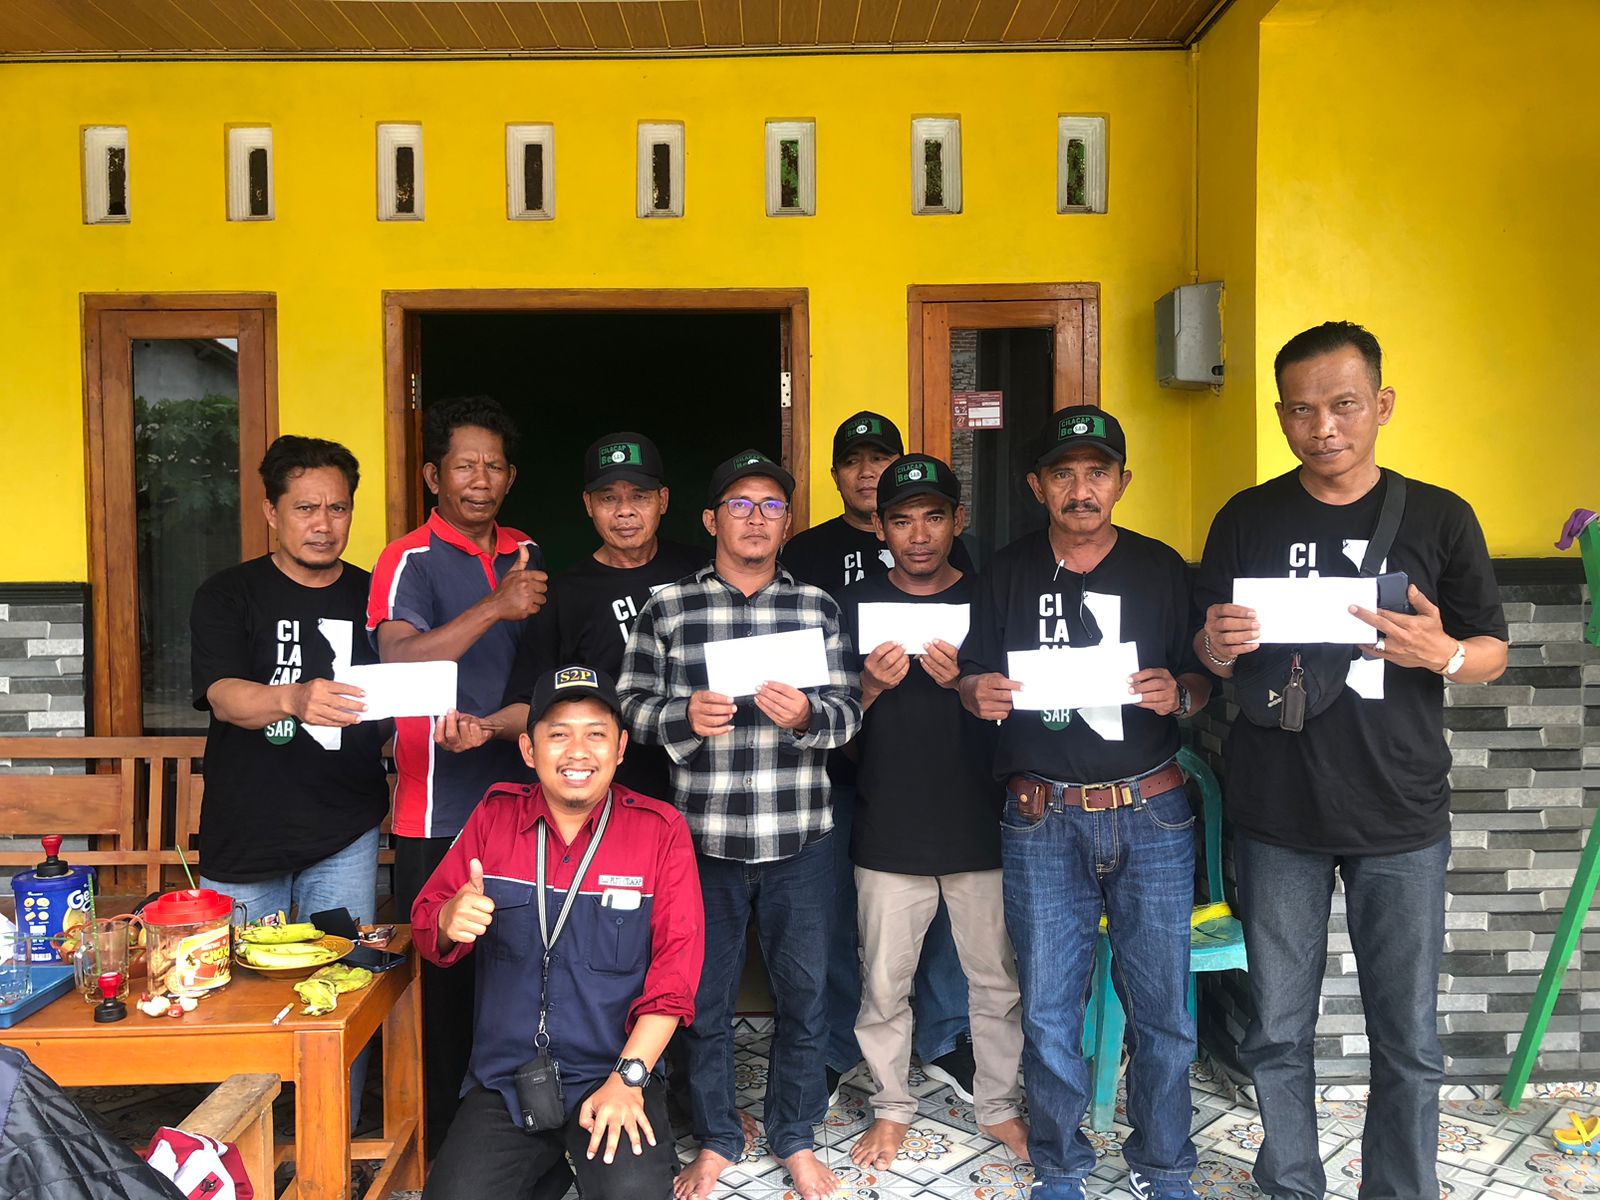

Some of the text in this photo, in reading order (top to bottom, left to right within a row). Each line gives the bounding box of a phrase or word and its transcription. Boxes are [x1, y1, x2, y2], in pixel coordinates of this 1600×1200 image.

[1061, 417, 1091, 428] CILACAP
[897, 463, 924, 473] CILACAP
[844, 550, 862, 569] CI
[1289, 542, 1317, 568] CI
[611, 595, 638, 621] CI
[1039, 592, 1063, 617] CI
[277, 619, 300, 642] CI
[1039, 618, 1070, 643] LA
[276, 642, 302, 666] LA
[269, 666, 302, 686] CAP
[560, 670, 592, 683] S2P
[1043, 708, 1070, 723] SAR
[266, 720, 294, 738] SAR
